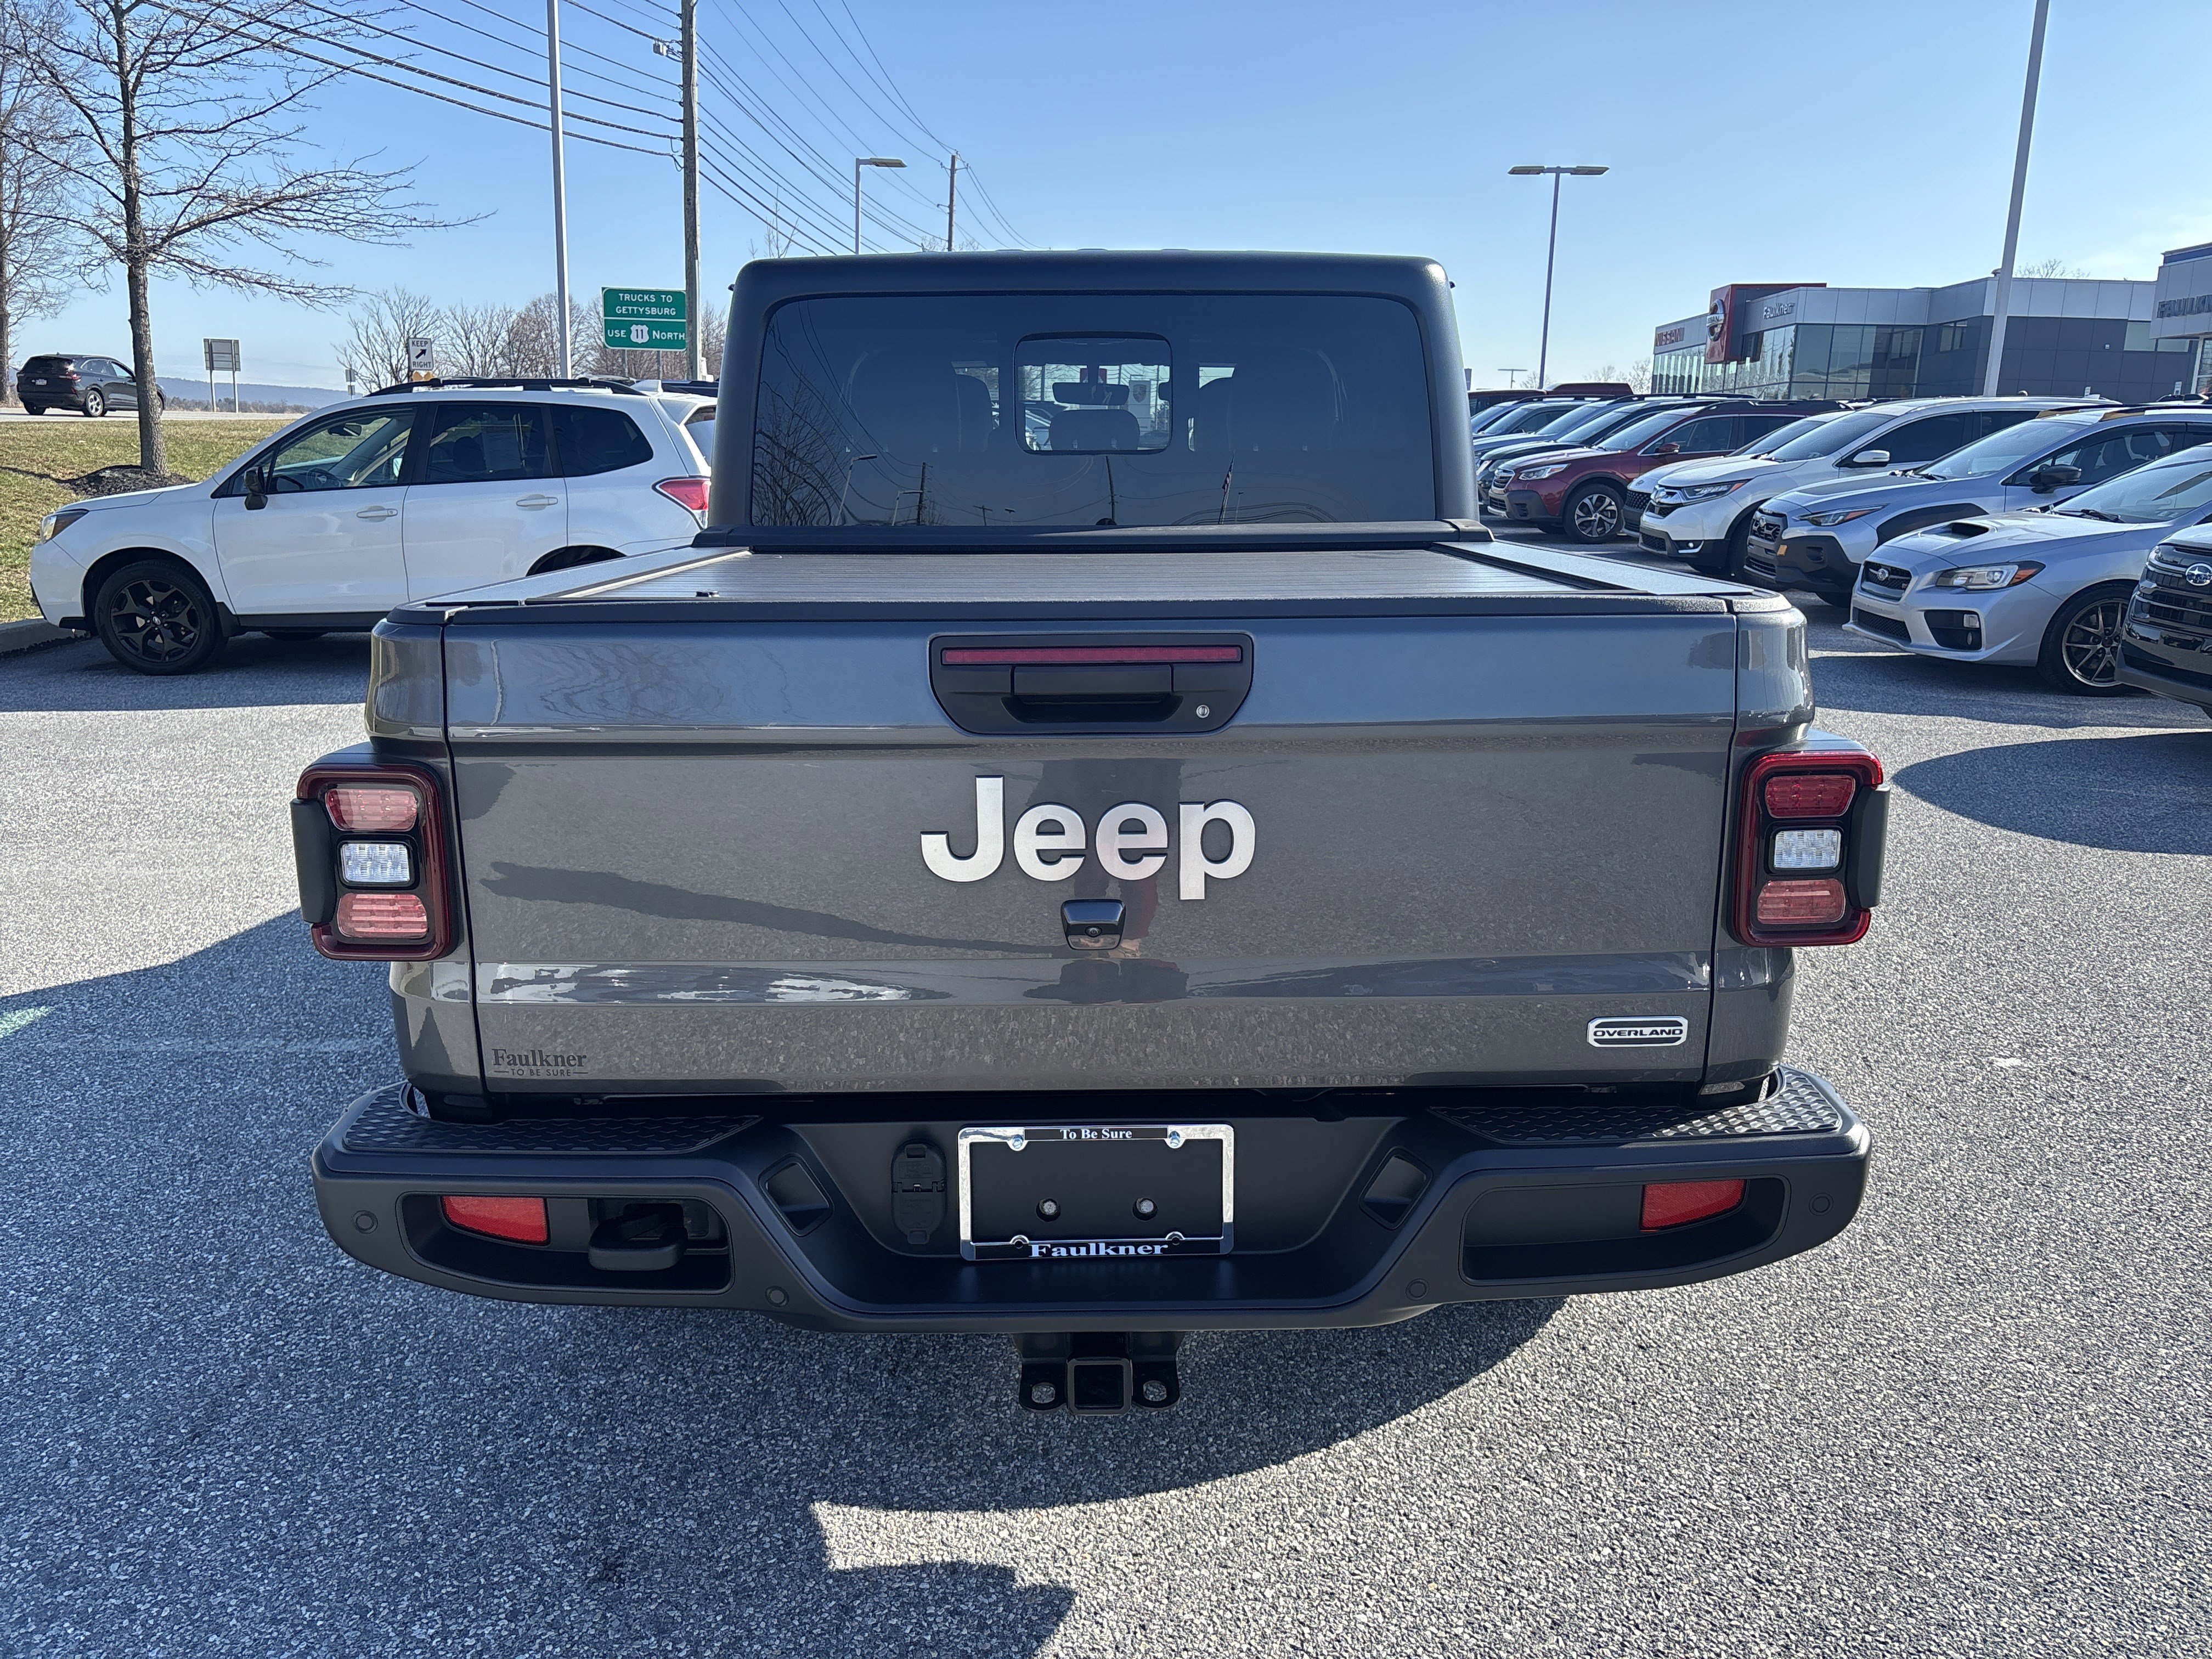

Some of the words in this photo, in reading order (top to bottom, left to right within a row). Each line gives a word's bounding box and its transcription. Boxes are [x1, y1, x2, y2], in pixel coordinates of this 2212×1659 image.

[618, 293, 656, 302] TRUCKS
[661, 295, 673, 303] TO
[616, 306, 676, 315] GETTYSBURG
[1763, 302, 1795, 319] Faulkner
[607, 329, 627, 338] USE
[635, 329, 644, 340] 11
[652, 330, 685, 341] NORTH
[1655, 327, 1685, 346] NISSAN
[920, 775, 1256, 900] Jeep
[1593, 1029, 1683, 1037] OVERLAND
[492, 1048, 587, 1067] Faulkner
[1060, 1128, 1077, 1139] To
[1081, 1128, 1098, 1139] Be
[1102, 1128, 1133, 1139] Sure
[1029, 1243, 1169, 1257] Faulkner
